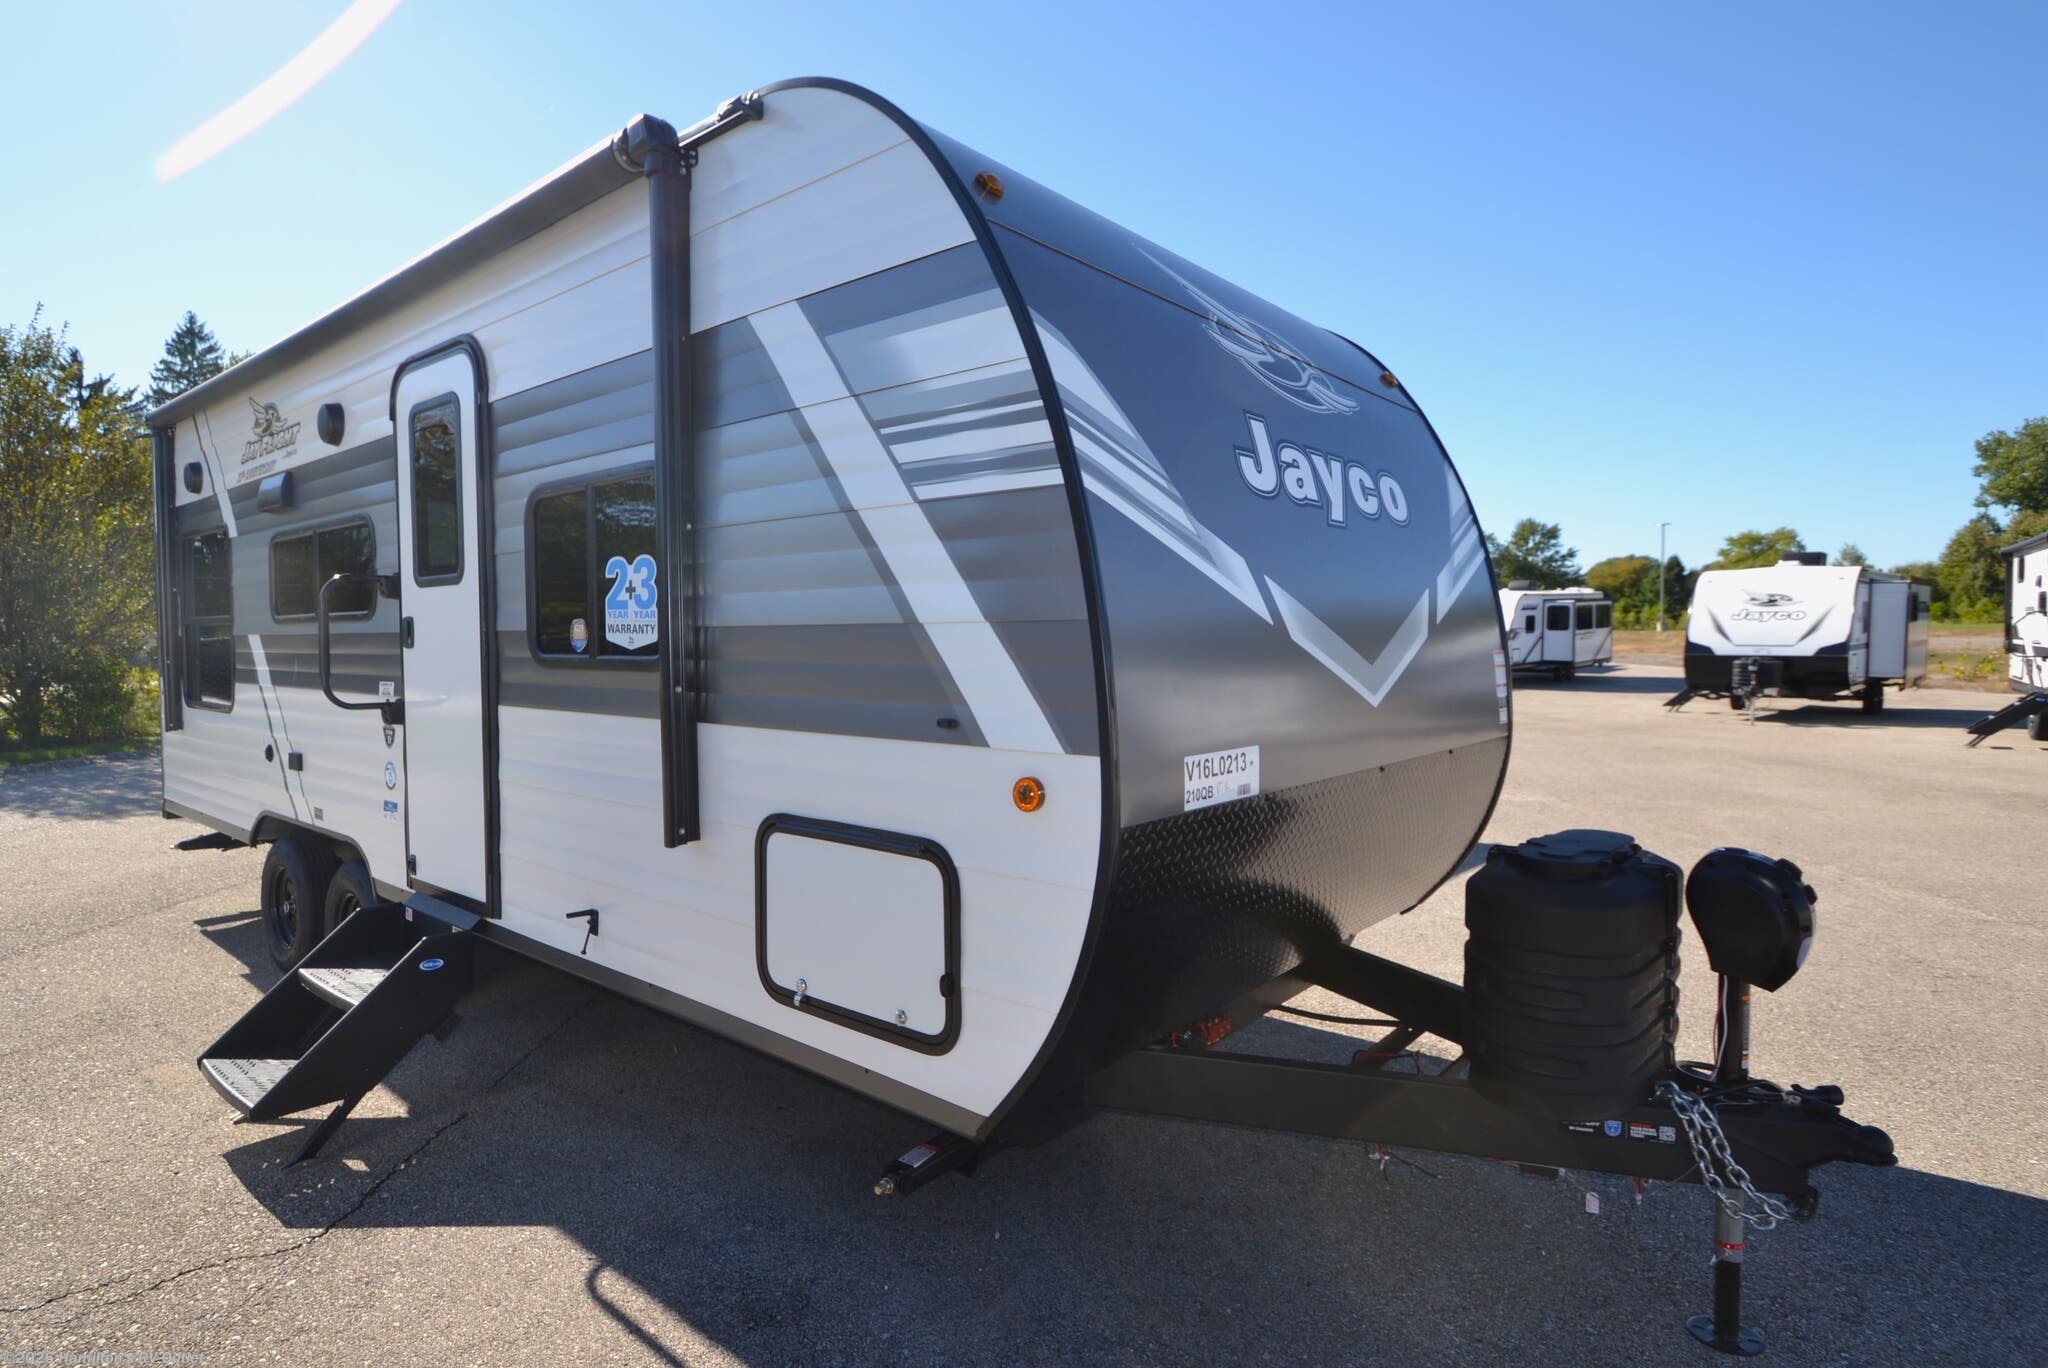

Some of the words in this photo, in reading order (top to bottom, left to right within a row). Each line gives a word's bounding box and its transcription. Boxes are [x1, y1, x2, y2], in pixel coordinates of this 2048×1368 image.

[1234, 410, 1410, 527] Jayco
[608, 610, 629, 619] YEAR
[633, 610, 656, 619] YEAR
[1731, 608, 1806, 623] Jayco
[607, 623, 656, 634] WARRANTY
[1185, 752, 1247, 782] V16L0213
[1186, 785, 1214, 804] 210QB
